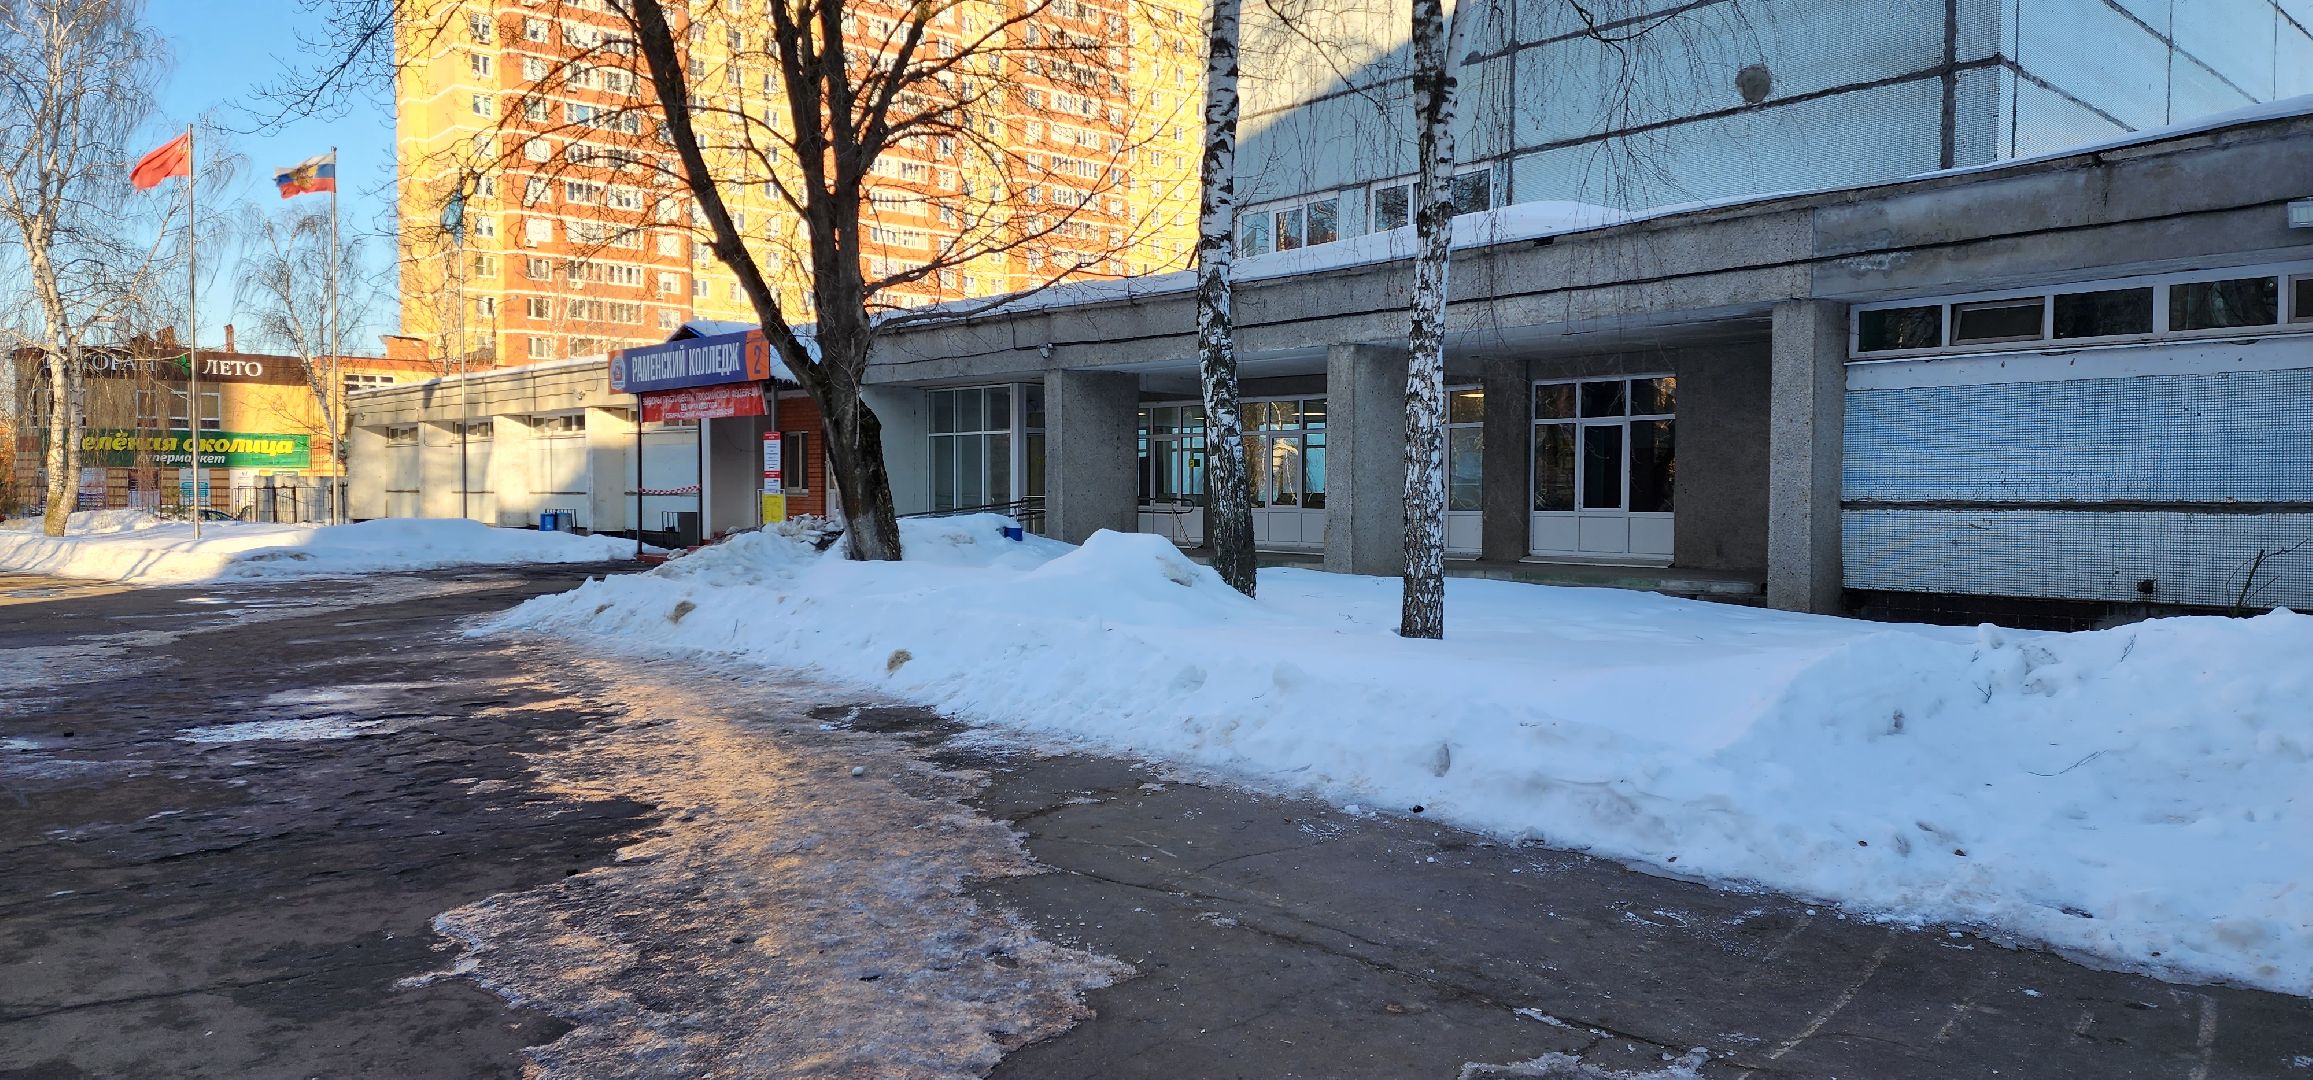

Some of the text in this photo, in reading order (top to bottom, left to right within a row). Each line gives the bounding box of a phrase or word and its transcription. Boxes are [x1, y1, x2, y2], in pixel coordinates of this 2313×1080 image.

[202, 359, 263, 377] ЛЕТО
[631, 342, 761, 382] РАМЕНСКИЙ КОЛЛЕДЖ 2
[81, 432, 178, 451] елёная
